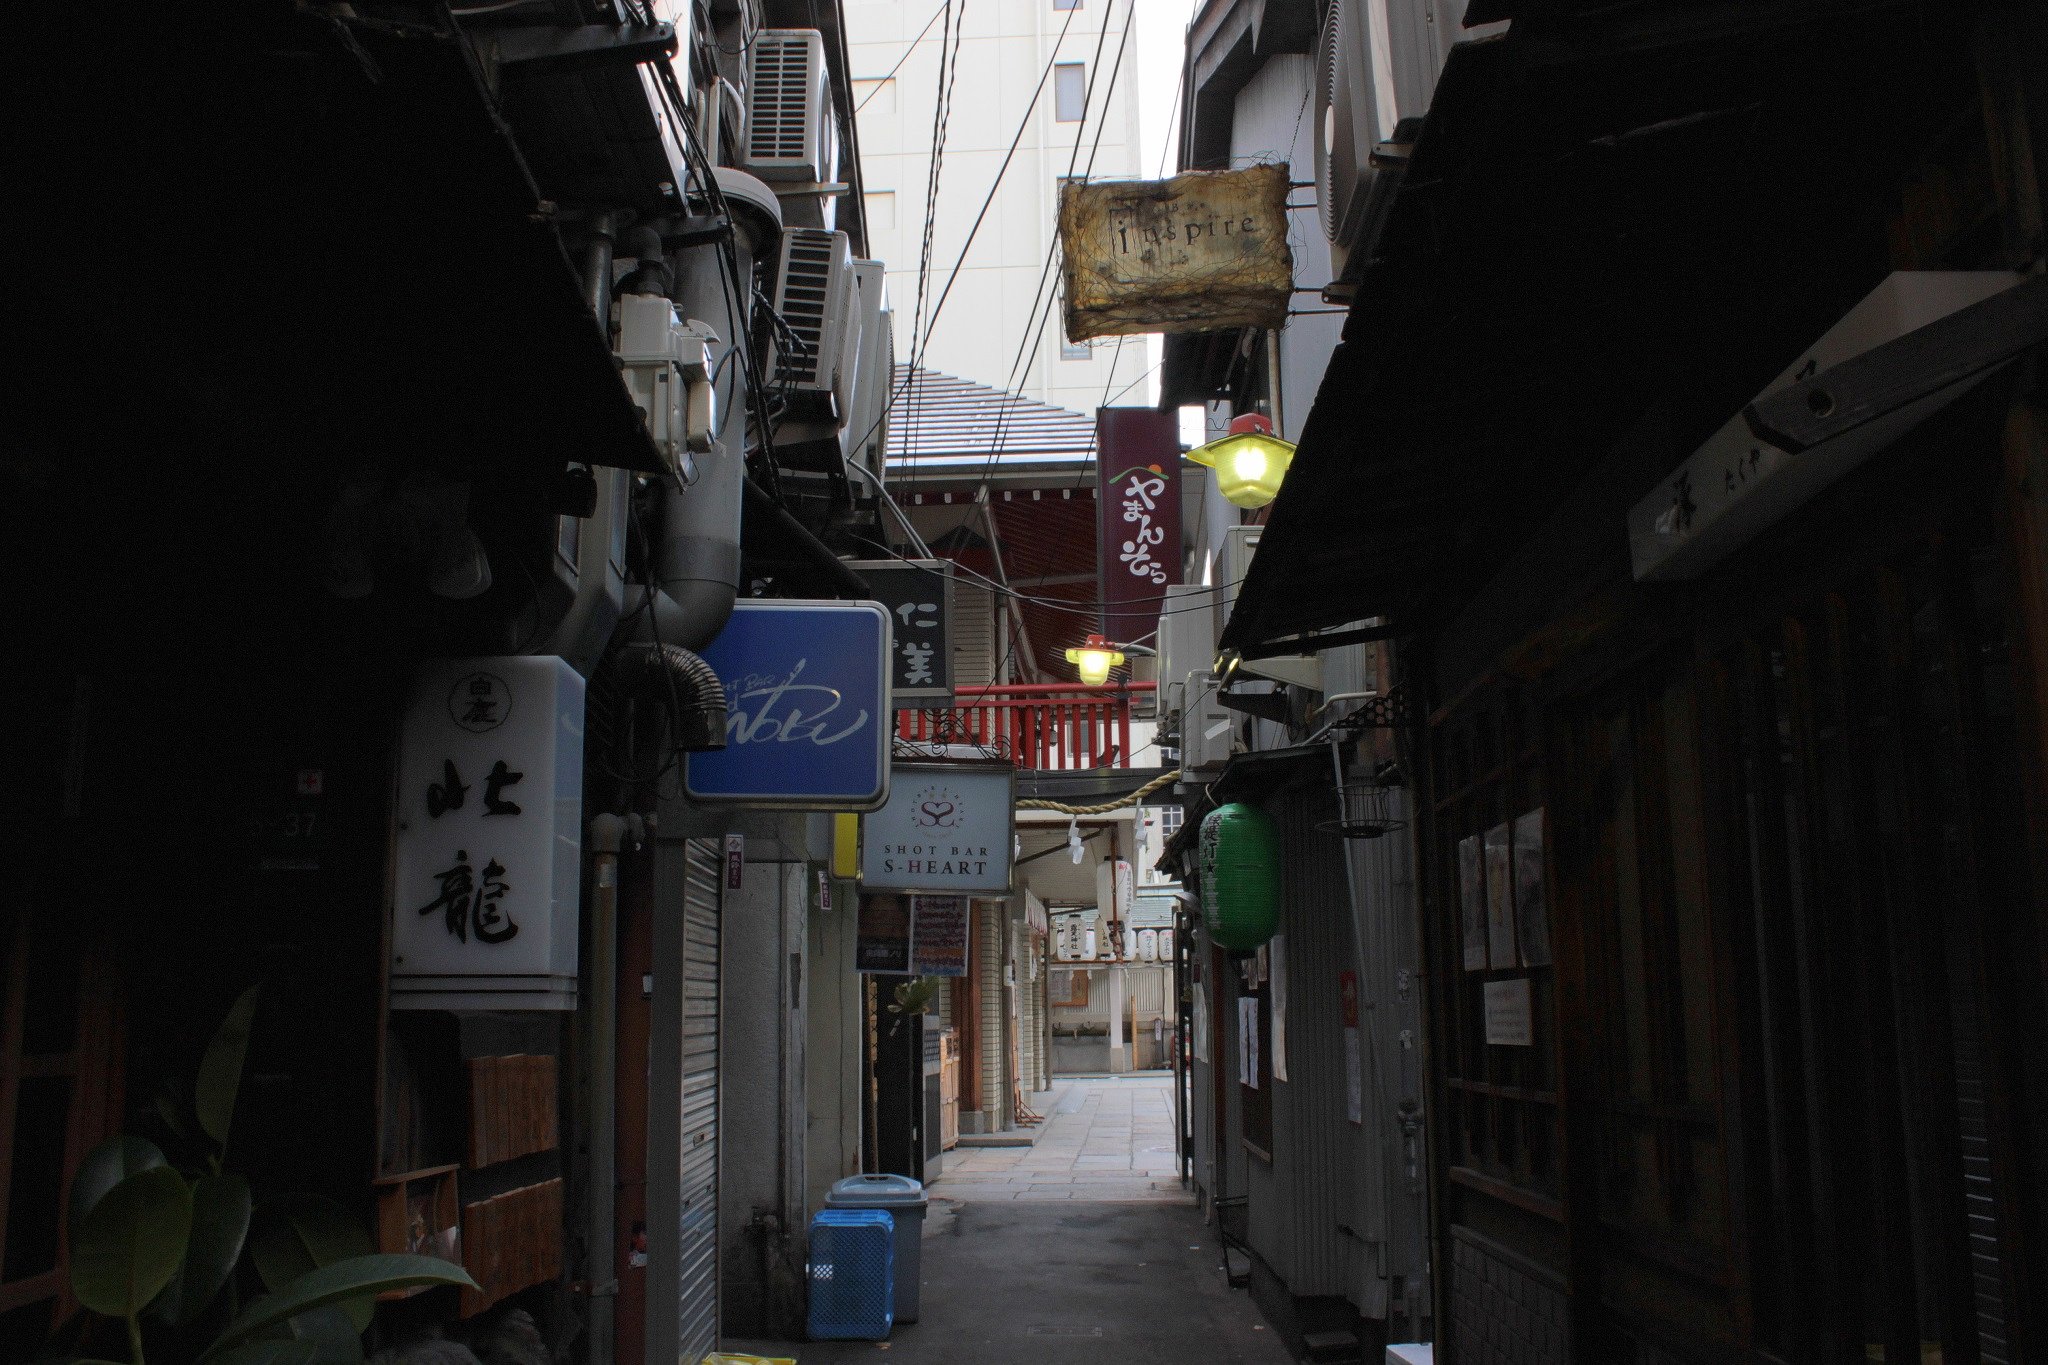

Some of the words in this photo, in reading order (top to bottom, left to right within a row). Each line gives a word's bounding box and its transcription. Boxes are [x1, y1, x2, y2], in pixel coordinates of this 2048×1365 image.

[1119, 475, 1167, 584] やまんそら
[884, 844, 937, 855] SHOT
[951, 846, 988, 856] BAR
[884, 859, 987, 875] S-HEART
